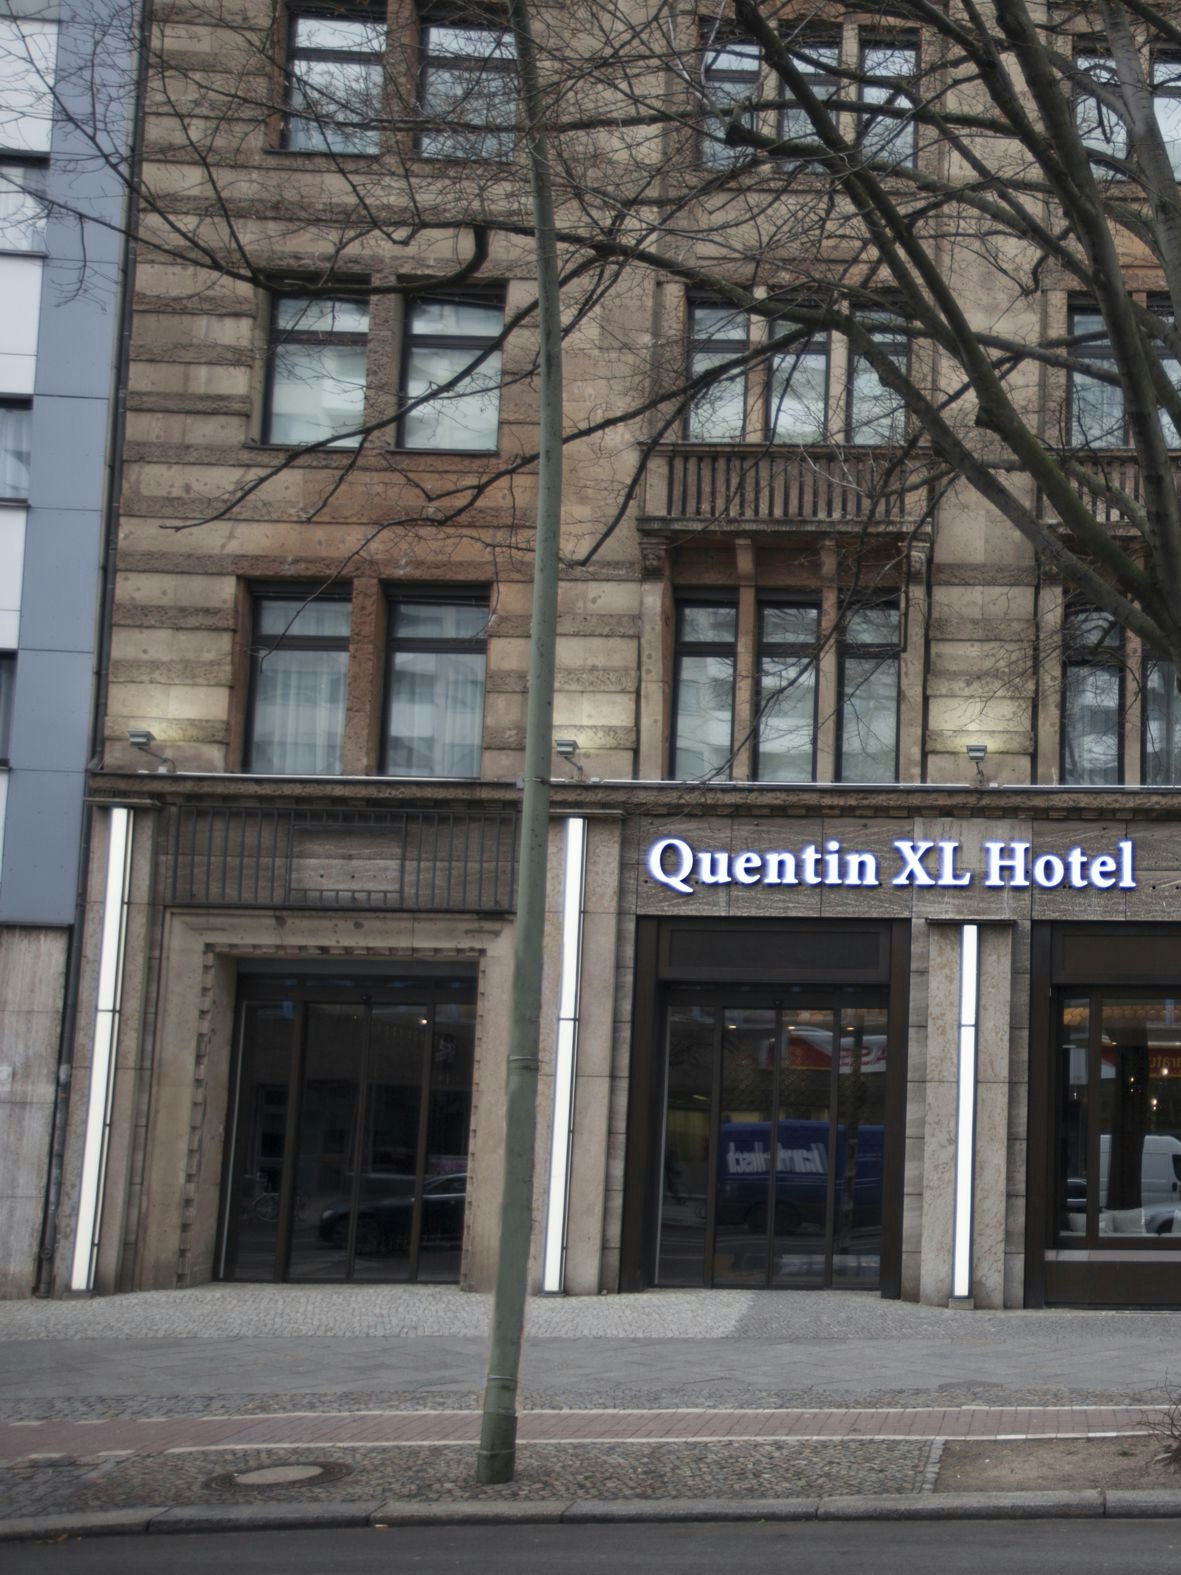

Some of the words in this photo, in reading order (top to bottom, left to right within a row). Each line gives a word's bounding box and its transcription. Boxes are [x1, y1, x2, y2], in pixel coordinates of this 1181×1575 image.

[648, 837, 880, 894] Quentin
[892, 840, 972, 888] XL
[984, 840, 1137, 889] Hotel
